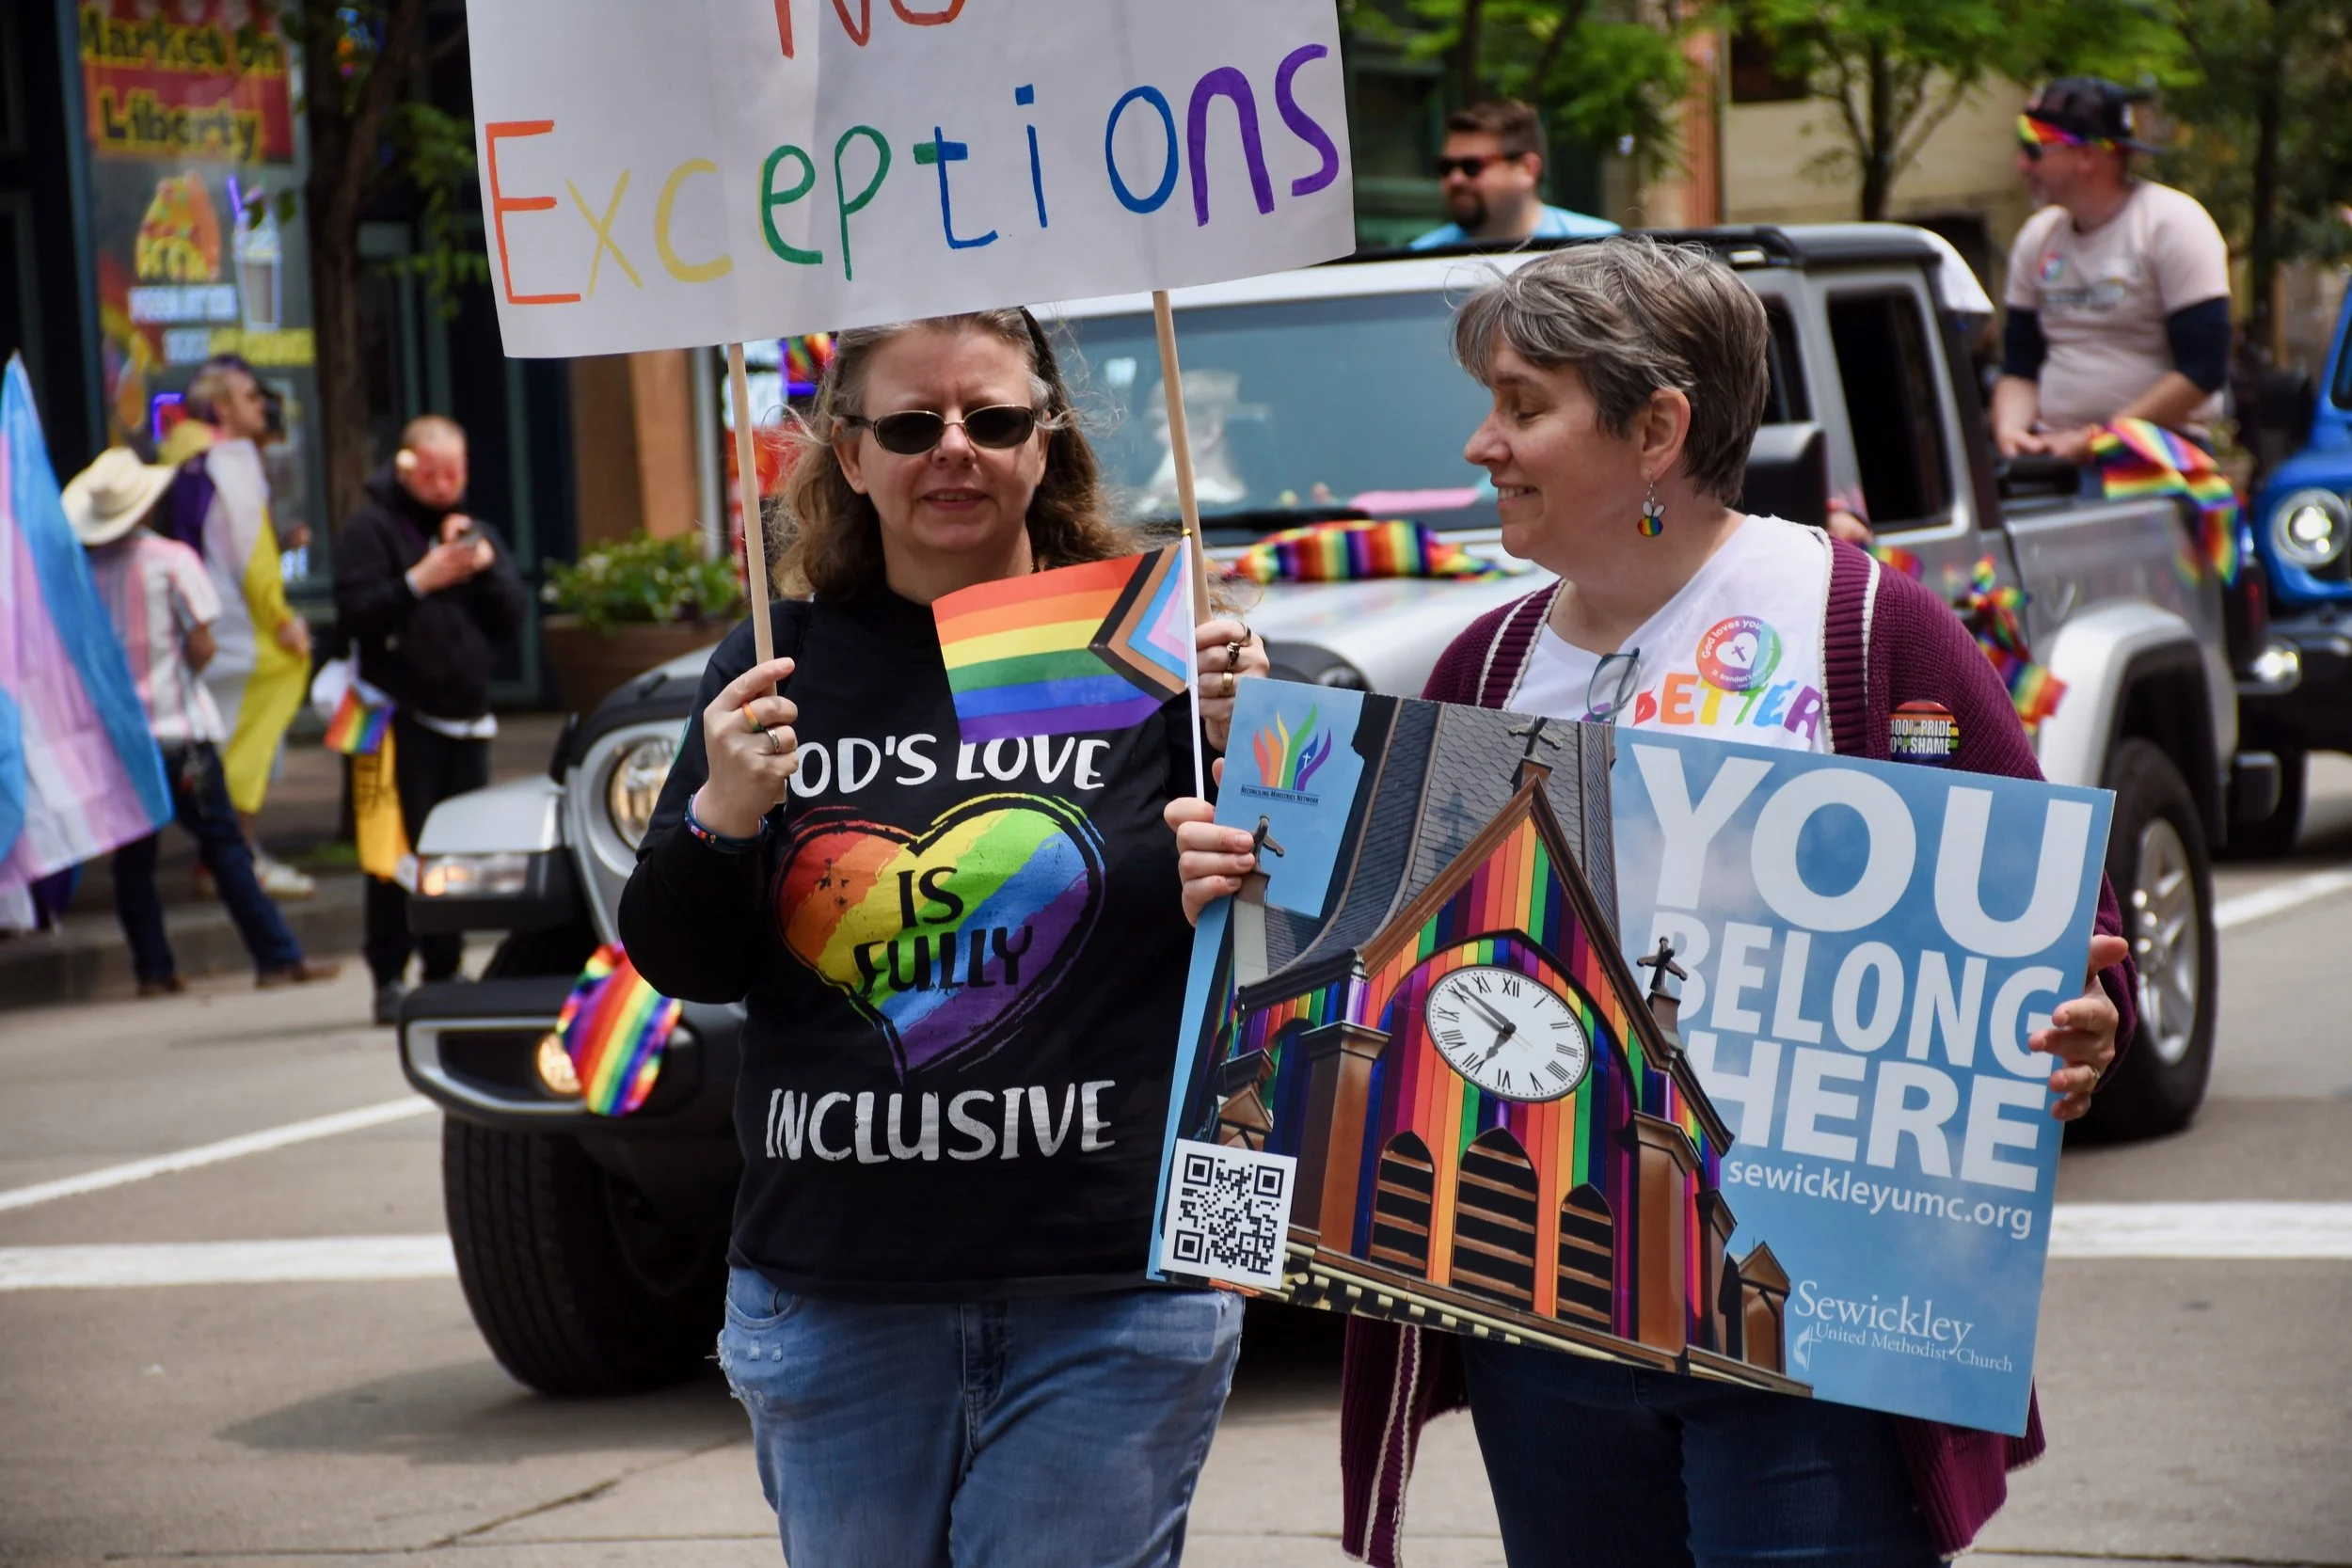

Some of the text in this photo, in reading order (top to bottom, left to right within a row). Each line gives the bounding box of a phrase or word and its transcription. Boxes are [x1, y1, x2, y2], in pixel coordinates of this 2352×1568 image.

[99, 93, 258, 164] Liberty
[485, 43, 1341, 304] Exceptions
[1701, 636, 1715, 659] God
[1711, 620, 1740, 639] loves
[1889, 736, 1951, 755] 0% SHAME
[1890, 719, 1952, 737] 100% PRIDE
[785, 733, 1111, 799] OD'S LOVE
[1630, 743, 2094, 958] YOU
[897, 865, 964, 928] IS
[853, 926, 1034, 993] FULLY
[1639, 911, 2065, 1079] BELONG
[765, 1080, 1117, 1164] INCLUSIVE
[1684, 1030, 2048, 1193] HERE
[1727, 1159, 2033, 1241] sewickleyumc.org
[1794, 1280, 1975, 1355] Sewickley
[1816, 1322, 2013, 1372] United Methodist Church
